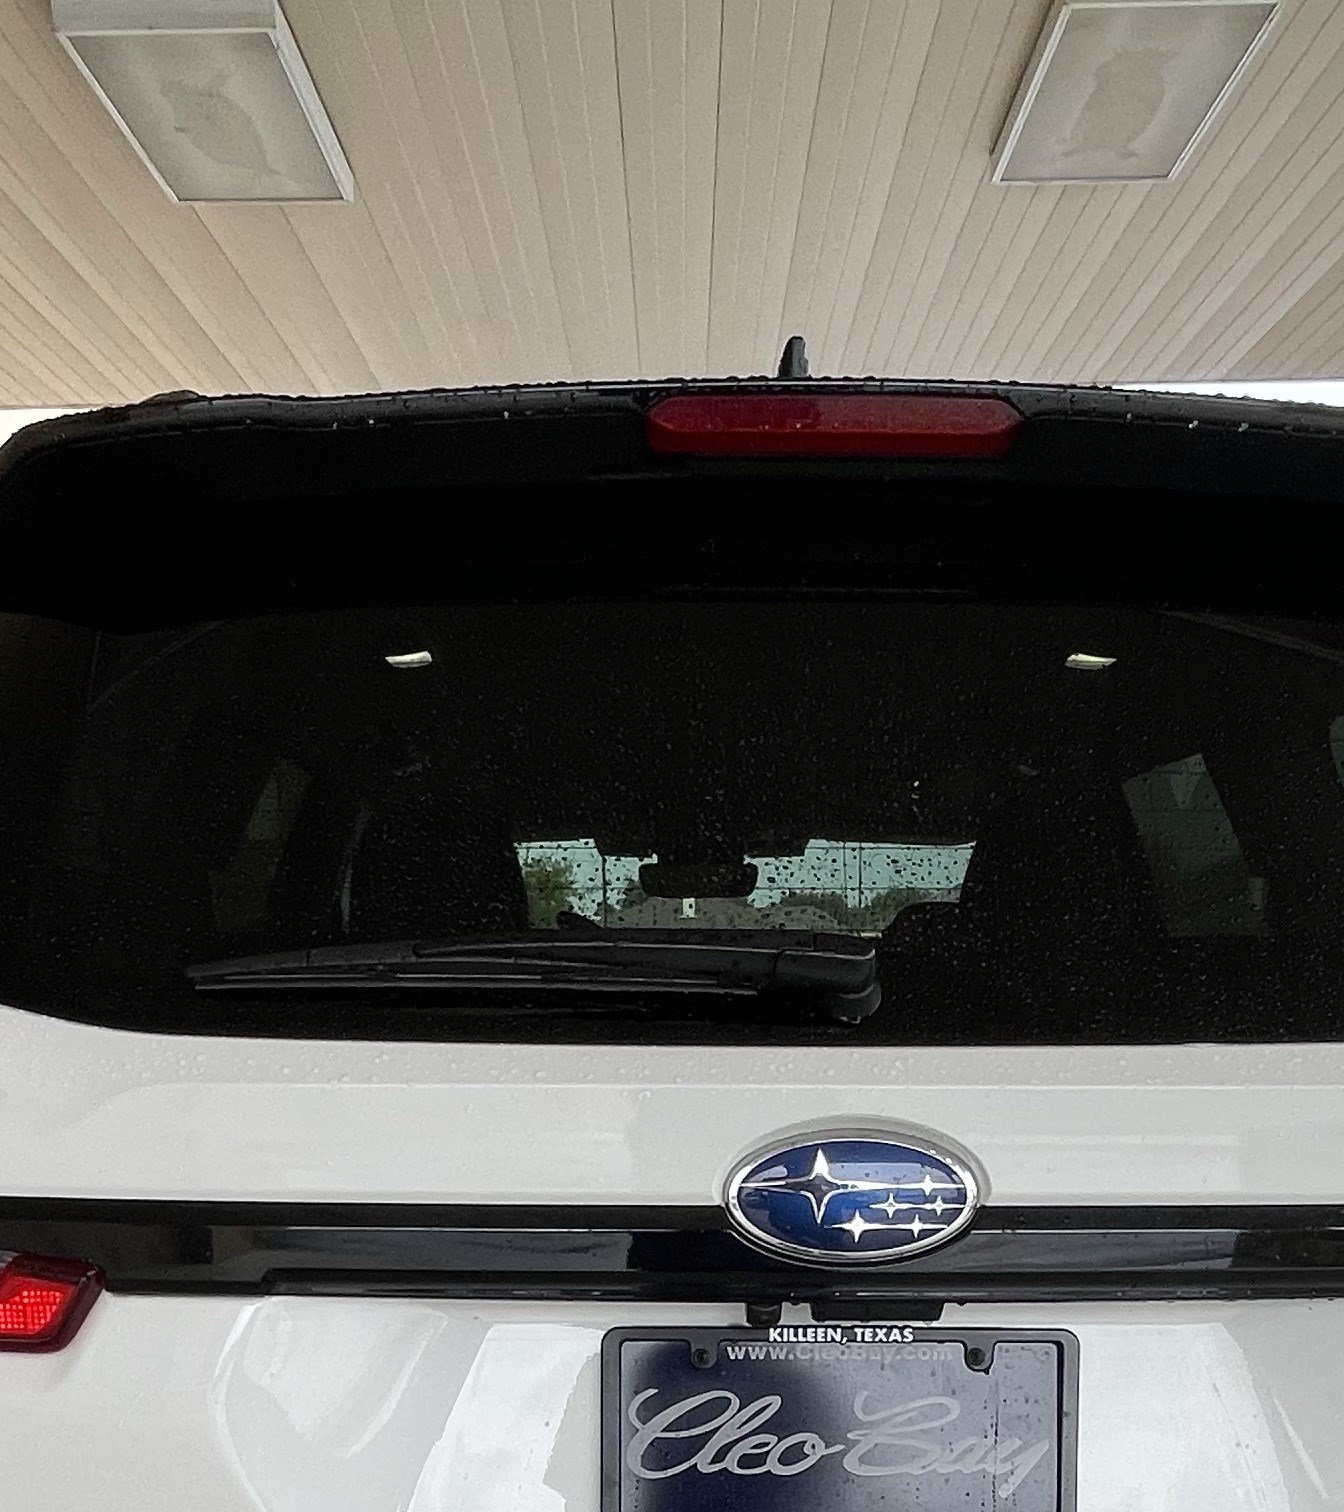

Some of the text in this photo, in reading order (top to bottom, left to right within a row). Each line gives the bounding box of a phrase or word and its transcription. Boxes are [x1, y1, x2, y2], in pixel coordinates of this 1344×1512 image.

[768, 1327, 914, 1344] KILLEEN, TEXAS
[627, 1389, 1050, 1498] Cleo Bay
